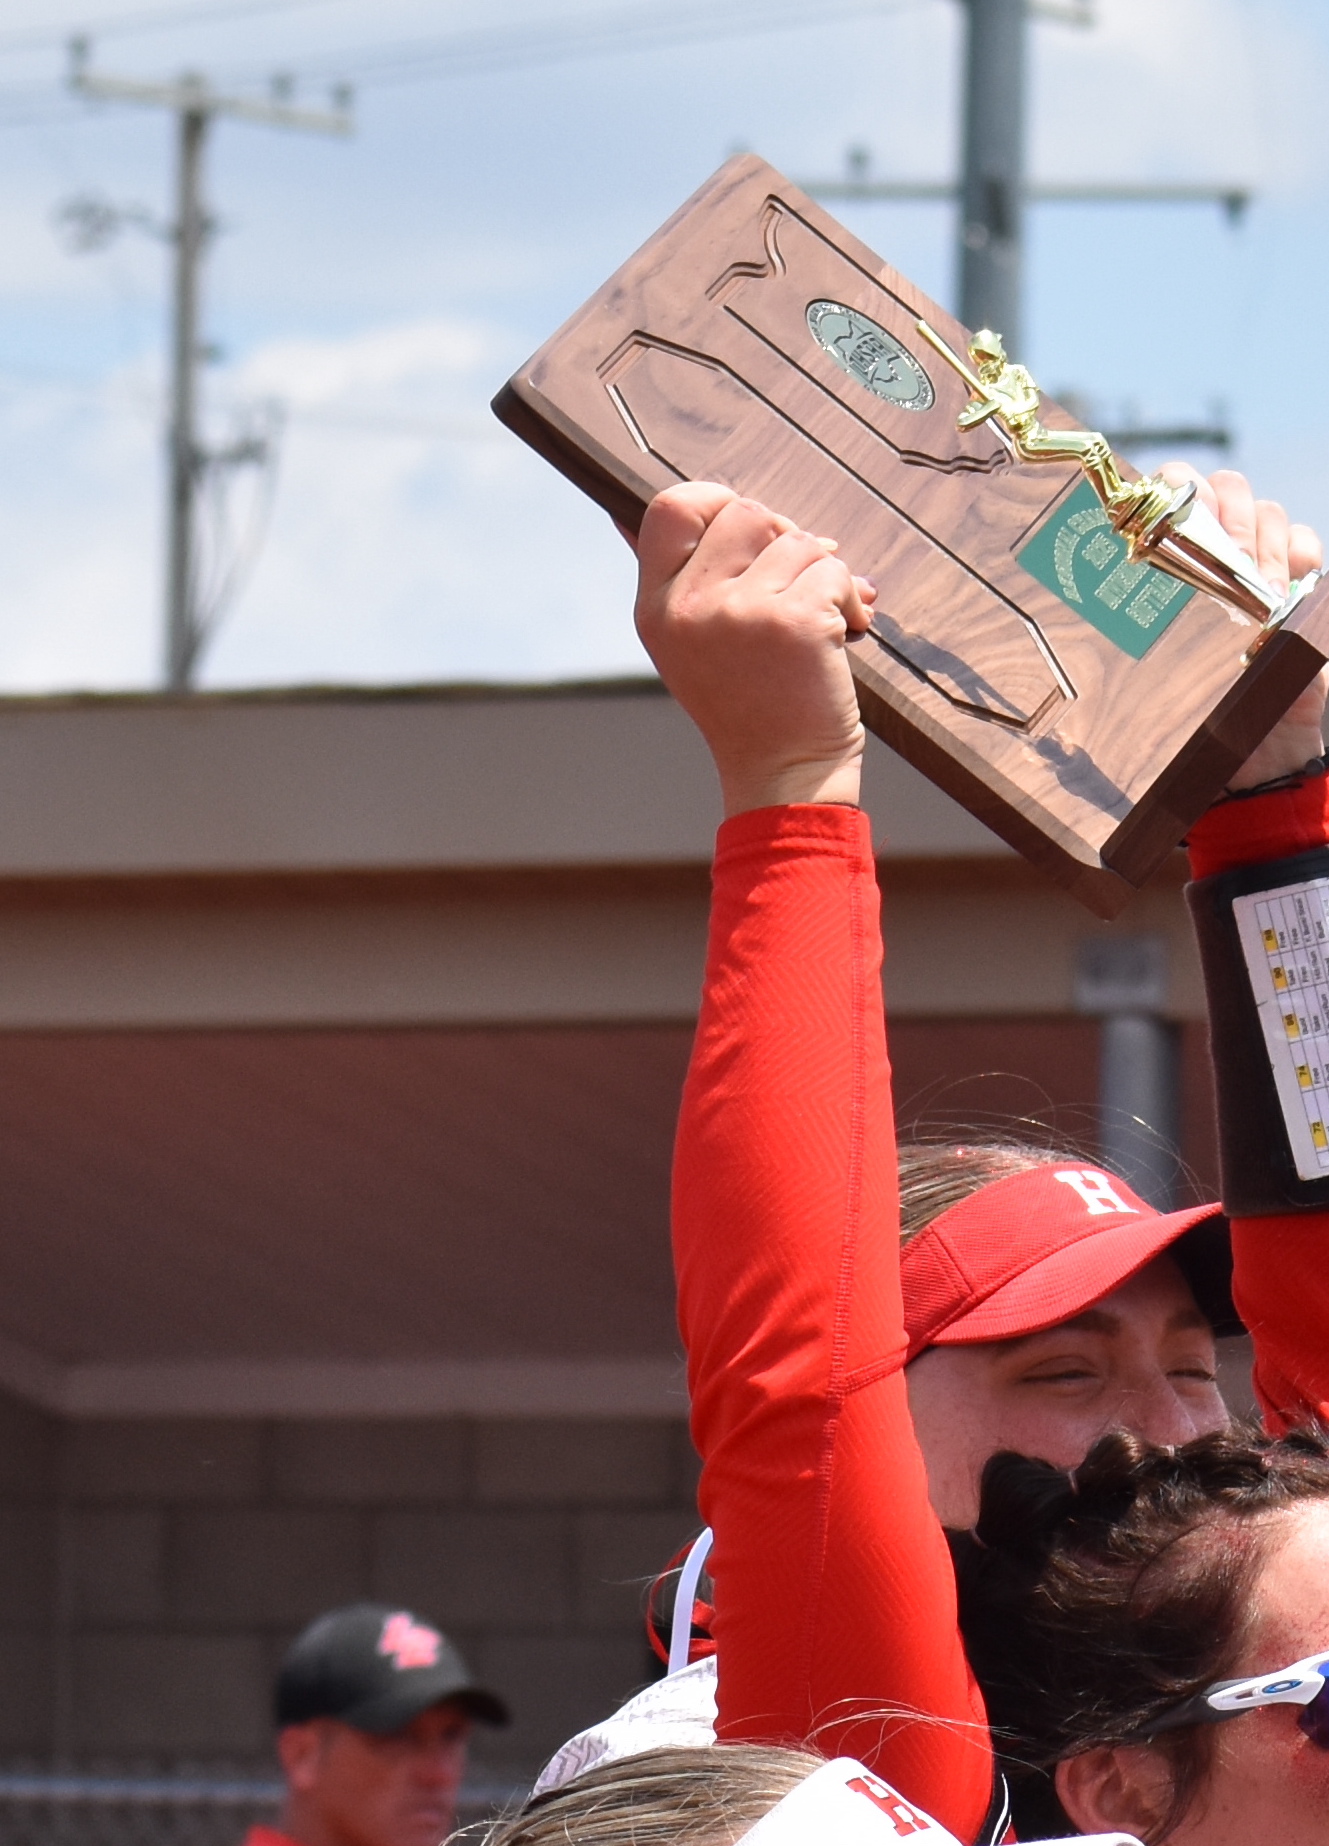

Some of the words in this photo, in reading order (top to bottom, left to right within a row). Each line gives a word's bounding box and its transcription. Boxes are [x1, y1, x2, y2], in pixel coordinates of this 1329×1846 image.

[1311, 1067, 1320, 1084] Free
[1055, 1169, 1140, 1215] H
[845, 1775, 931, 1837] H
